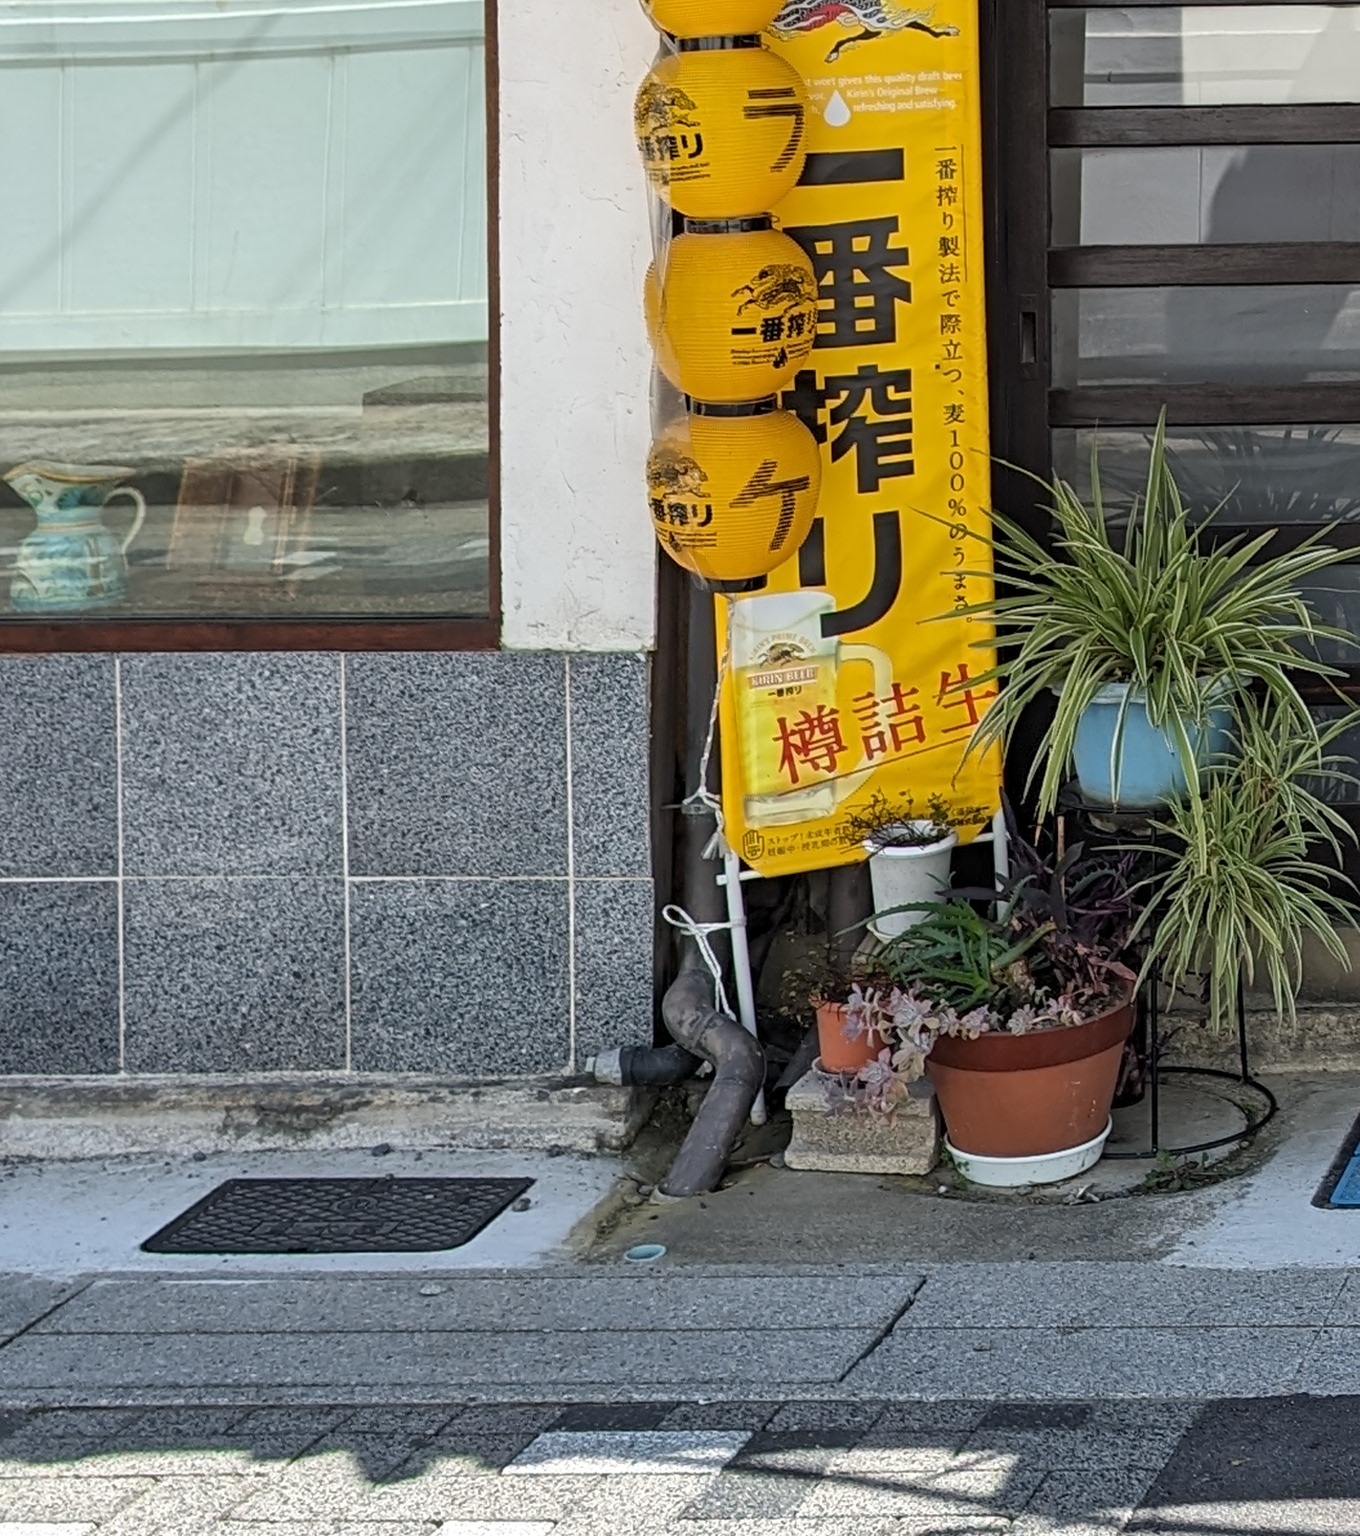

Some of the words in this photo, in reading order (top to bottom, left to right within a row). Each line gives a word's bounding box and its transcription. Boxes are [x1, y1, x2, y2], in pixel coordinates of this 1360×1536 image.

[884, 72, 916, 84] quality
[917, 70, 940, 82] draft
[743, 87, 805, 173] ラ
[782, 147, 914, 638] 一番搾り
[729, 458, 811, 555] ケ
